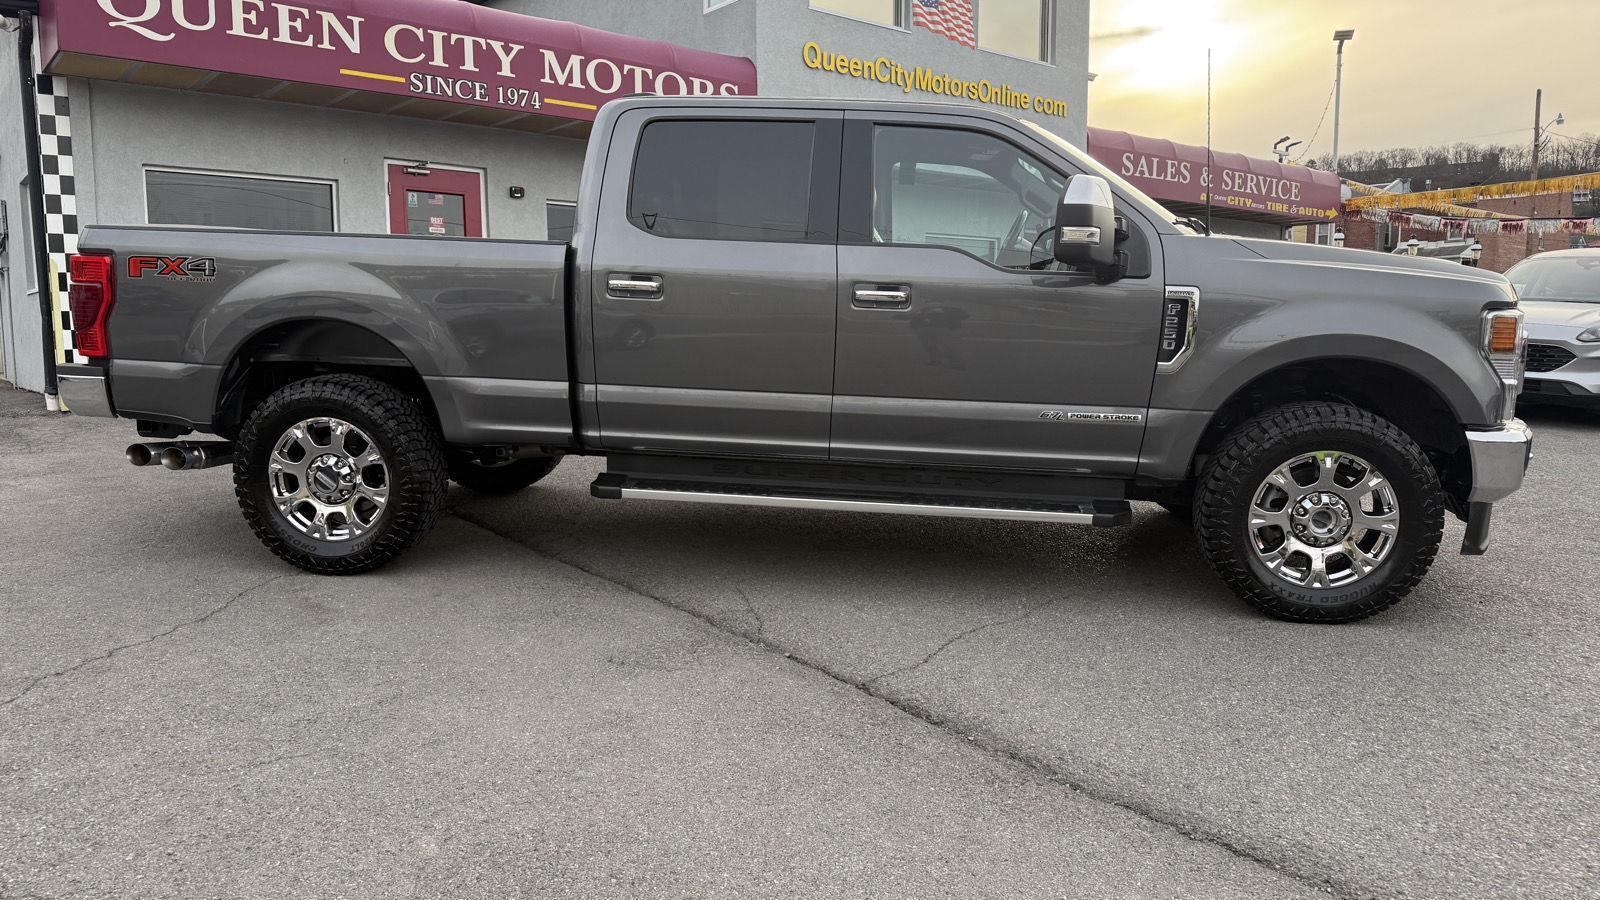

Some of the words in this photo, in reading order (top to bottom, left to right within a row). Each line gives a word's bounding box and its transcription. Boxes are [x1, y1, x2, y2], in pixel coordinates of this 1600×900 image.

[94, 0, 365, 54] QUEEN
[383, 23, 524, 78] CITY
[409, 72, 489, 102] SINCE
[495, 85, 543, 110] 1974
[1121, 152, 1191, 184] SALES
[1200, 166, 1214, 188] &
[1221, 169, 1301, 201] SERVICE
[1227, 195, 1253, 208] CITY
[1266, 201, 1289, 213] TIRE
[1290, 204, 1299, 214] &
[1298, 206, 1325, 218] AUTO
[127, 254, 217, 279] FX4
[1102, 414, 1140, 422] STROKE
